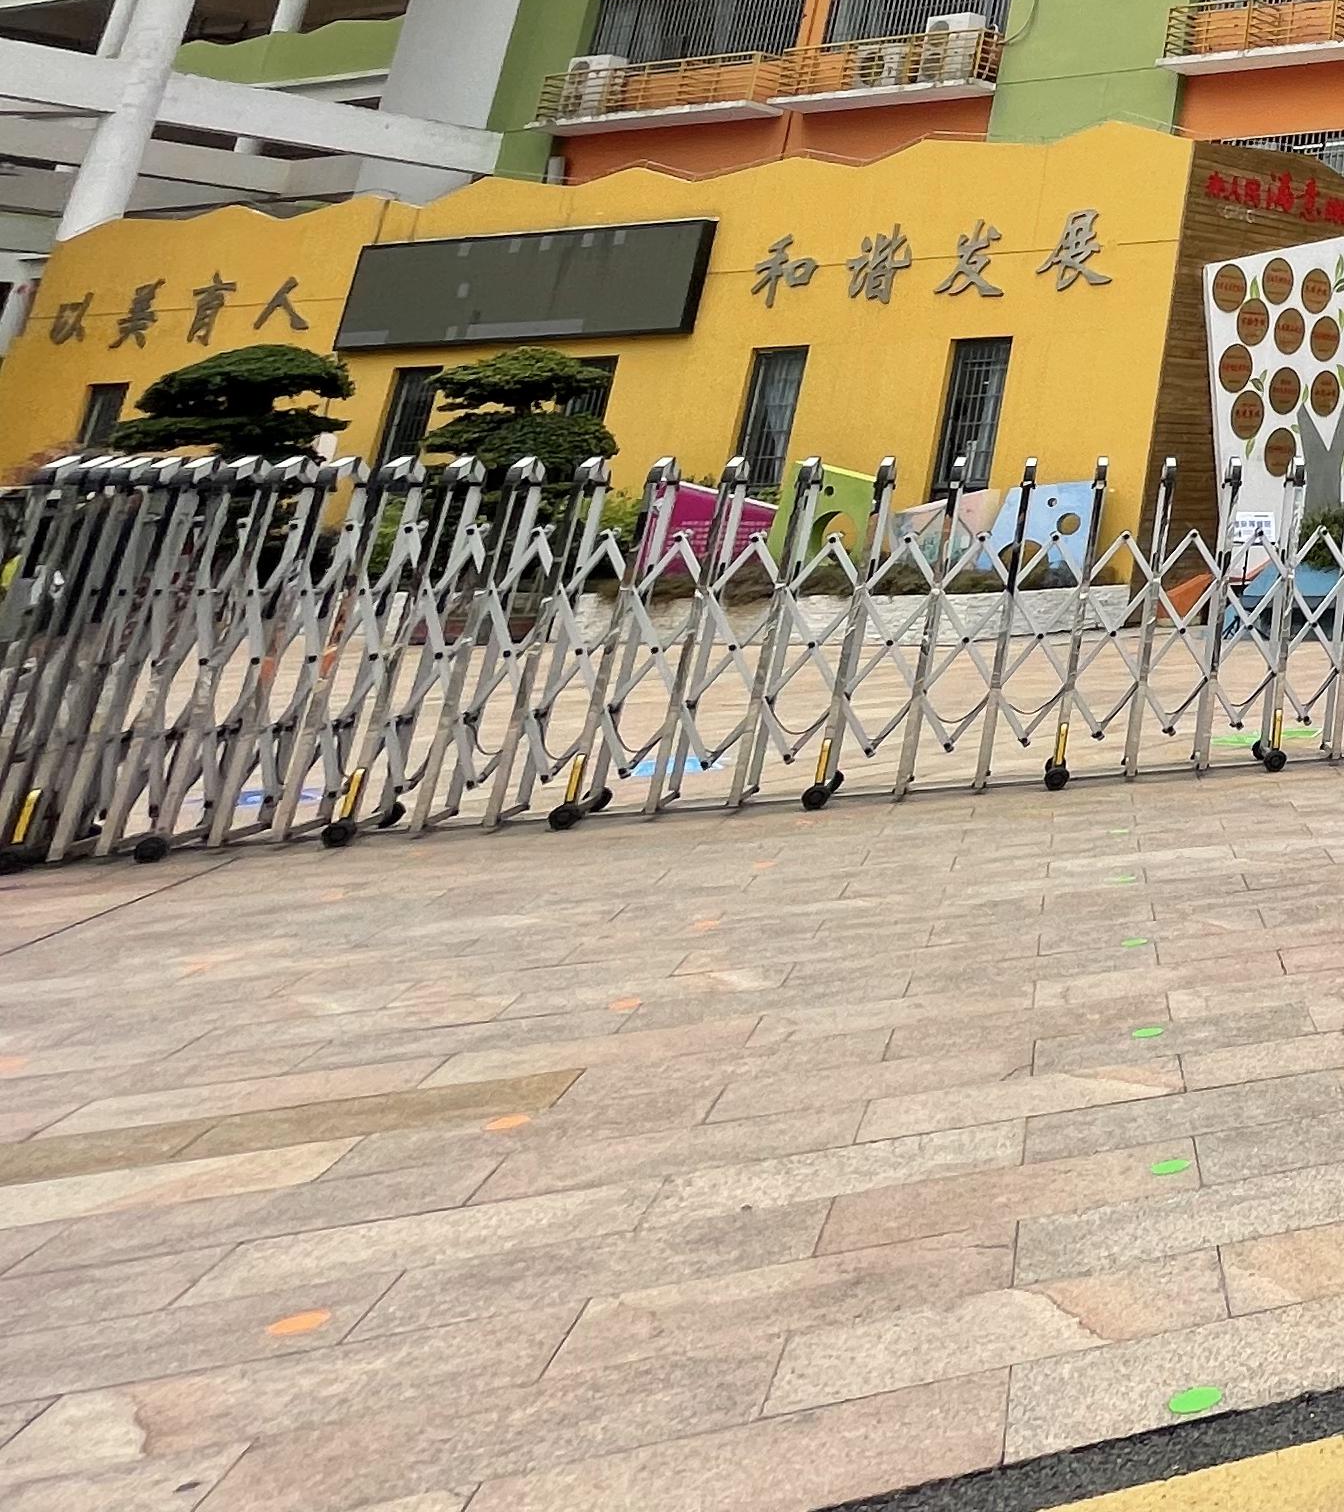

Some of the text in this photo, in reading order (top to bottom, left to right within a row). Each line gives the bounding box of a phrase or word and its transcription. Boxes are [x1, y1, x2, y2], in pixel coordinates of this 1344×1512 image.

[750, 208, 1113, 310] 和谐发展
[48, 270, 310, 351] 以美育人
